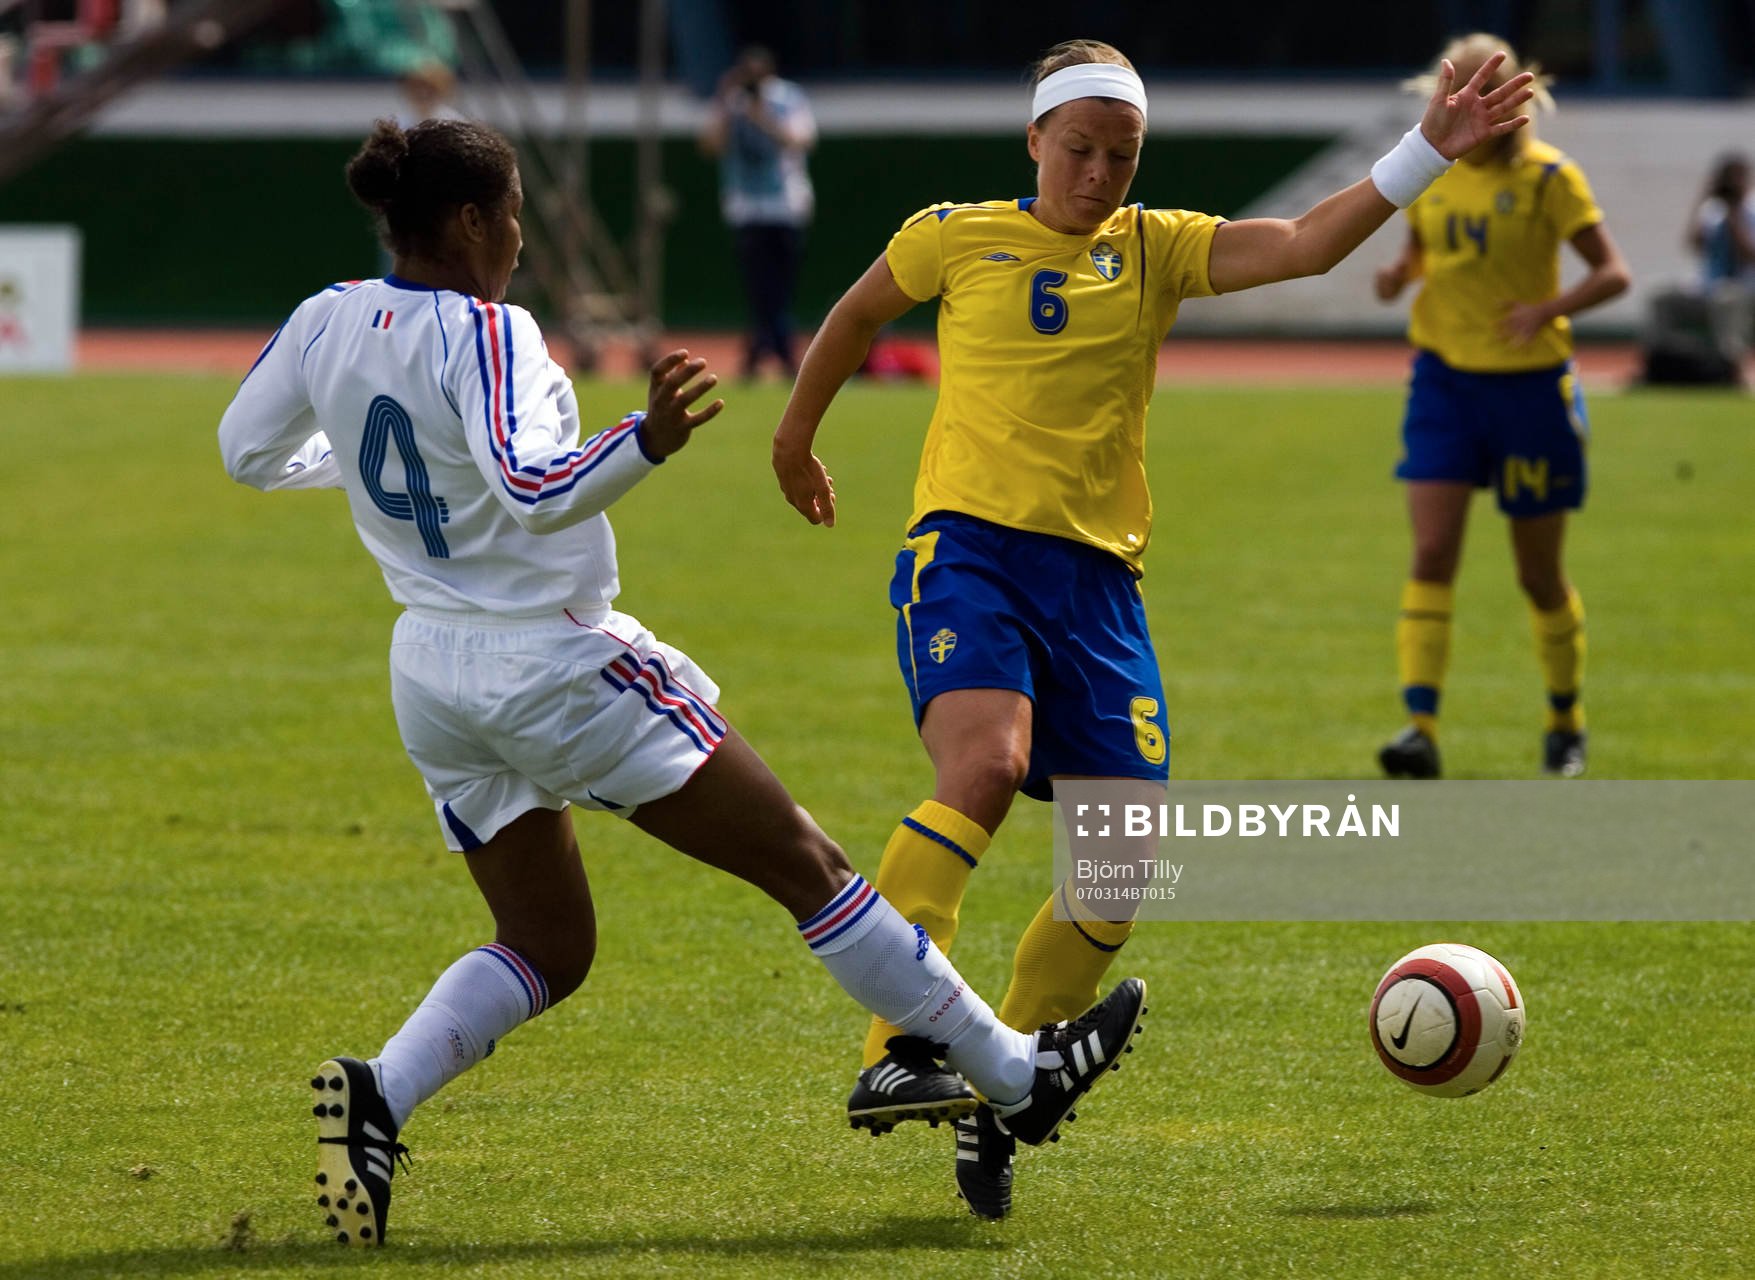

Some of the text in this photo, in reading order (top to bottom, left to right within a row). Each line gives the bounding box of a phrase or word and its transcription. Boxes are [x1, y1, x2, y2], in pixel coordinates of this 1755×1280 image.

[1446, 212, 1488, 255] 14
[1028, 267, 1069, 335] 6
[358, 394, 450, 560] 4
[1504, 456, 1549, 500] 14
[1129, 695, 1166, 765] 6
